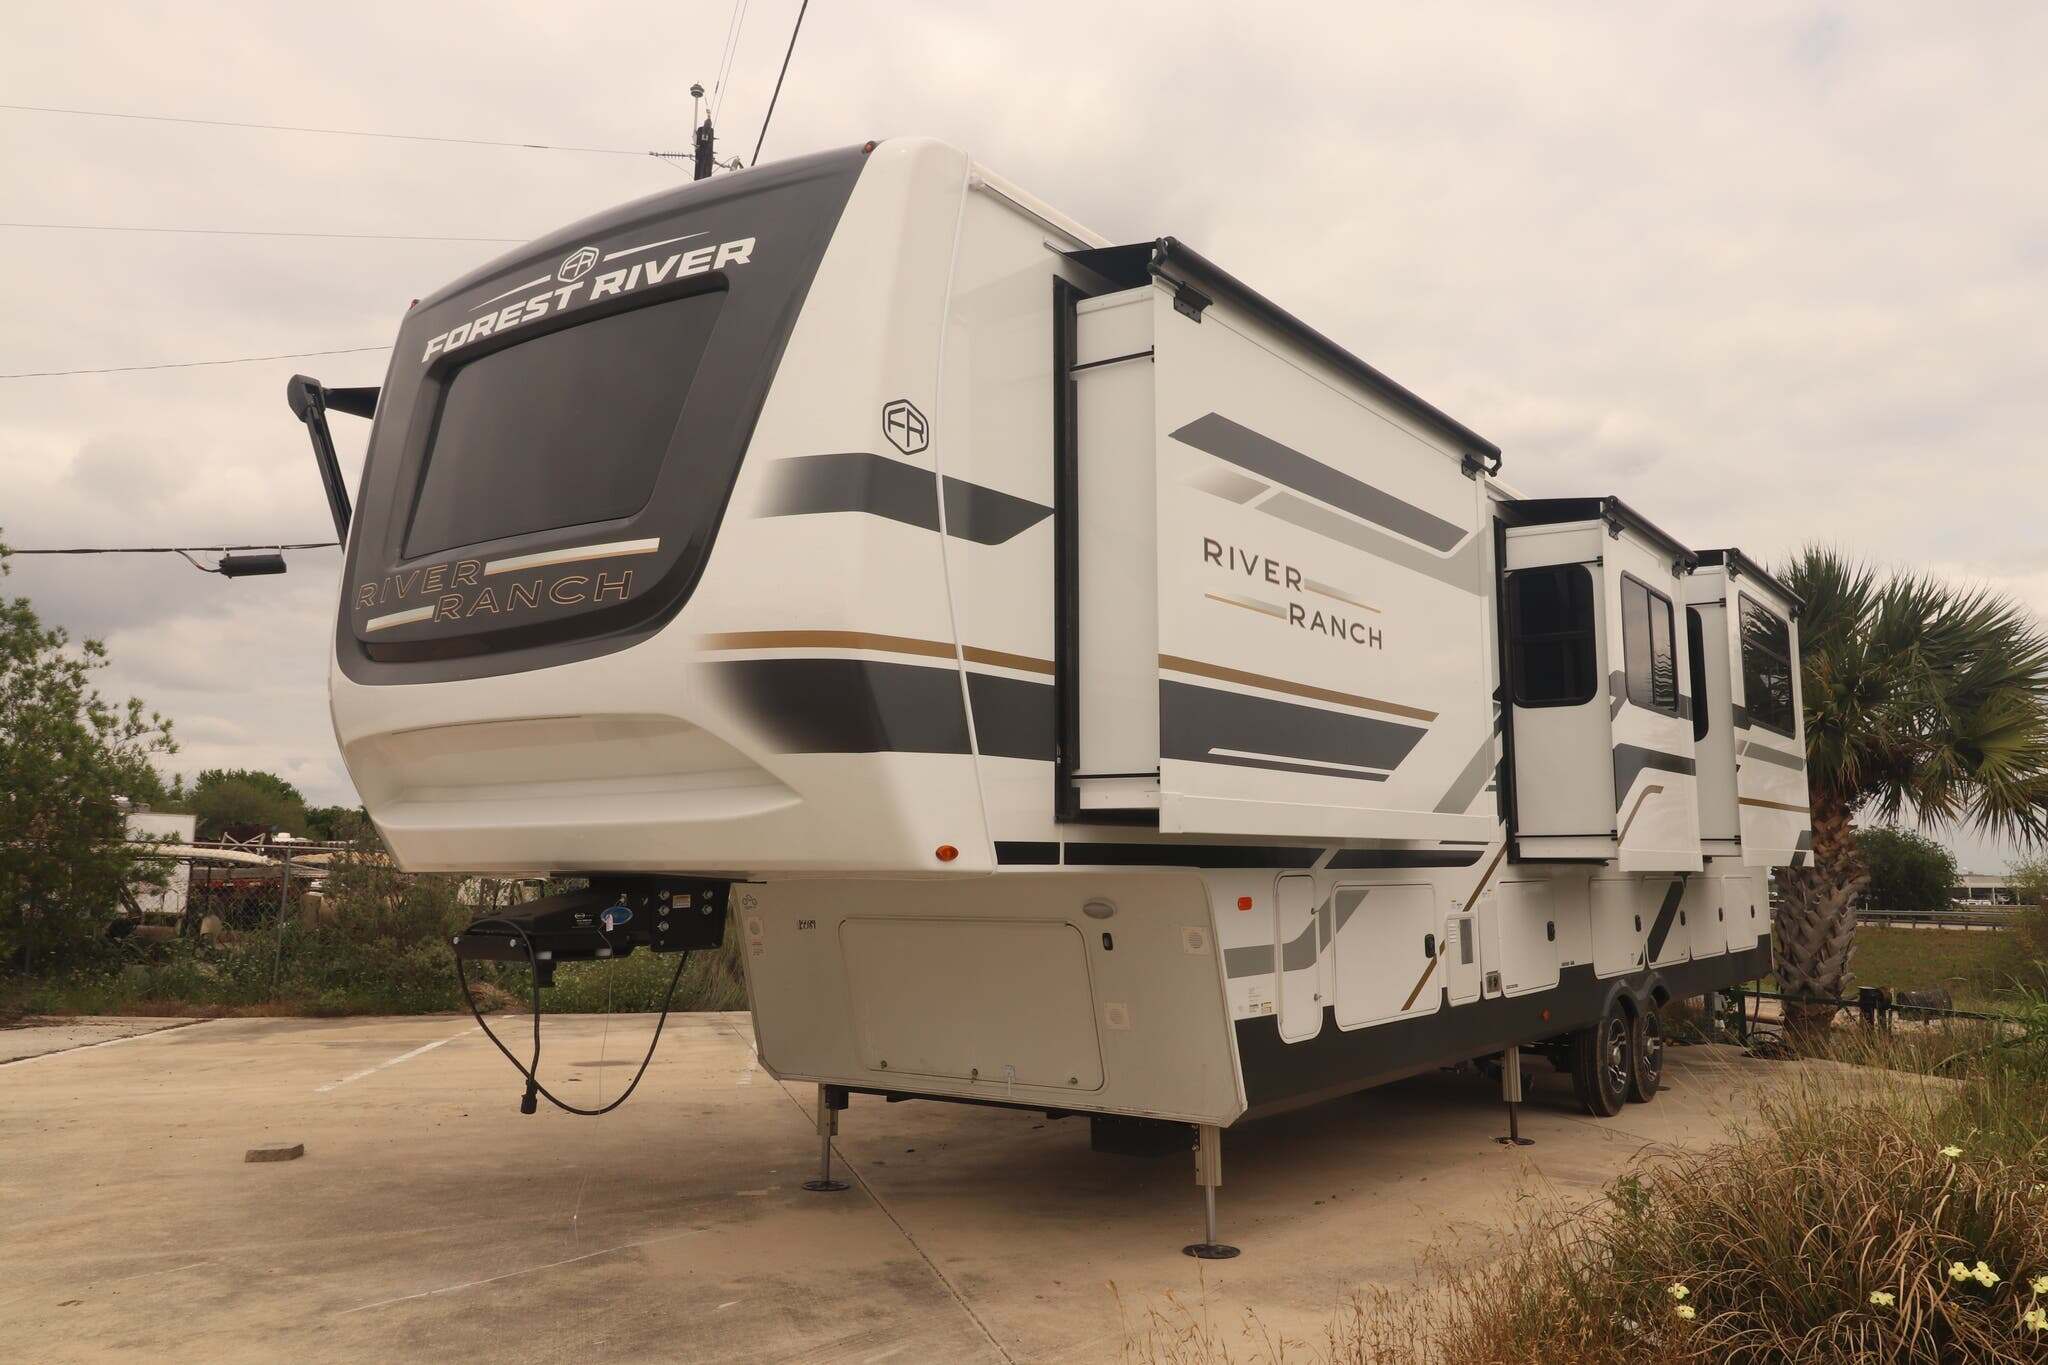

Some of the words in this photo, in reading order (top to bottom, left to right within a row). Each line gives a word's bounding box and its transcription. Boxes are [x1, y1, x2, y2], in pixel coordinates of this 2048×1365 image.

[421, 281, 584, 364] FOREST
[589, 237, 756, 301] RIVER
[355, 559, 480, 610] RIVER
[1203, 536, 1303, 593] RIVER
[432, 570, 633, 623] RANCH
[1289, 602, 1382, 650] RANCH
